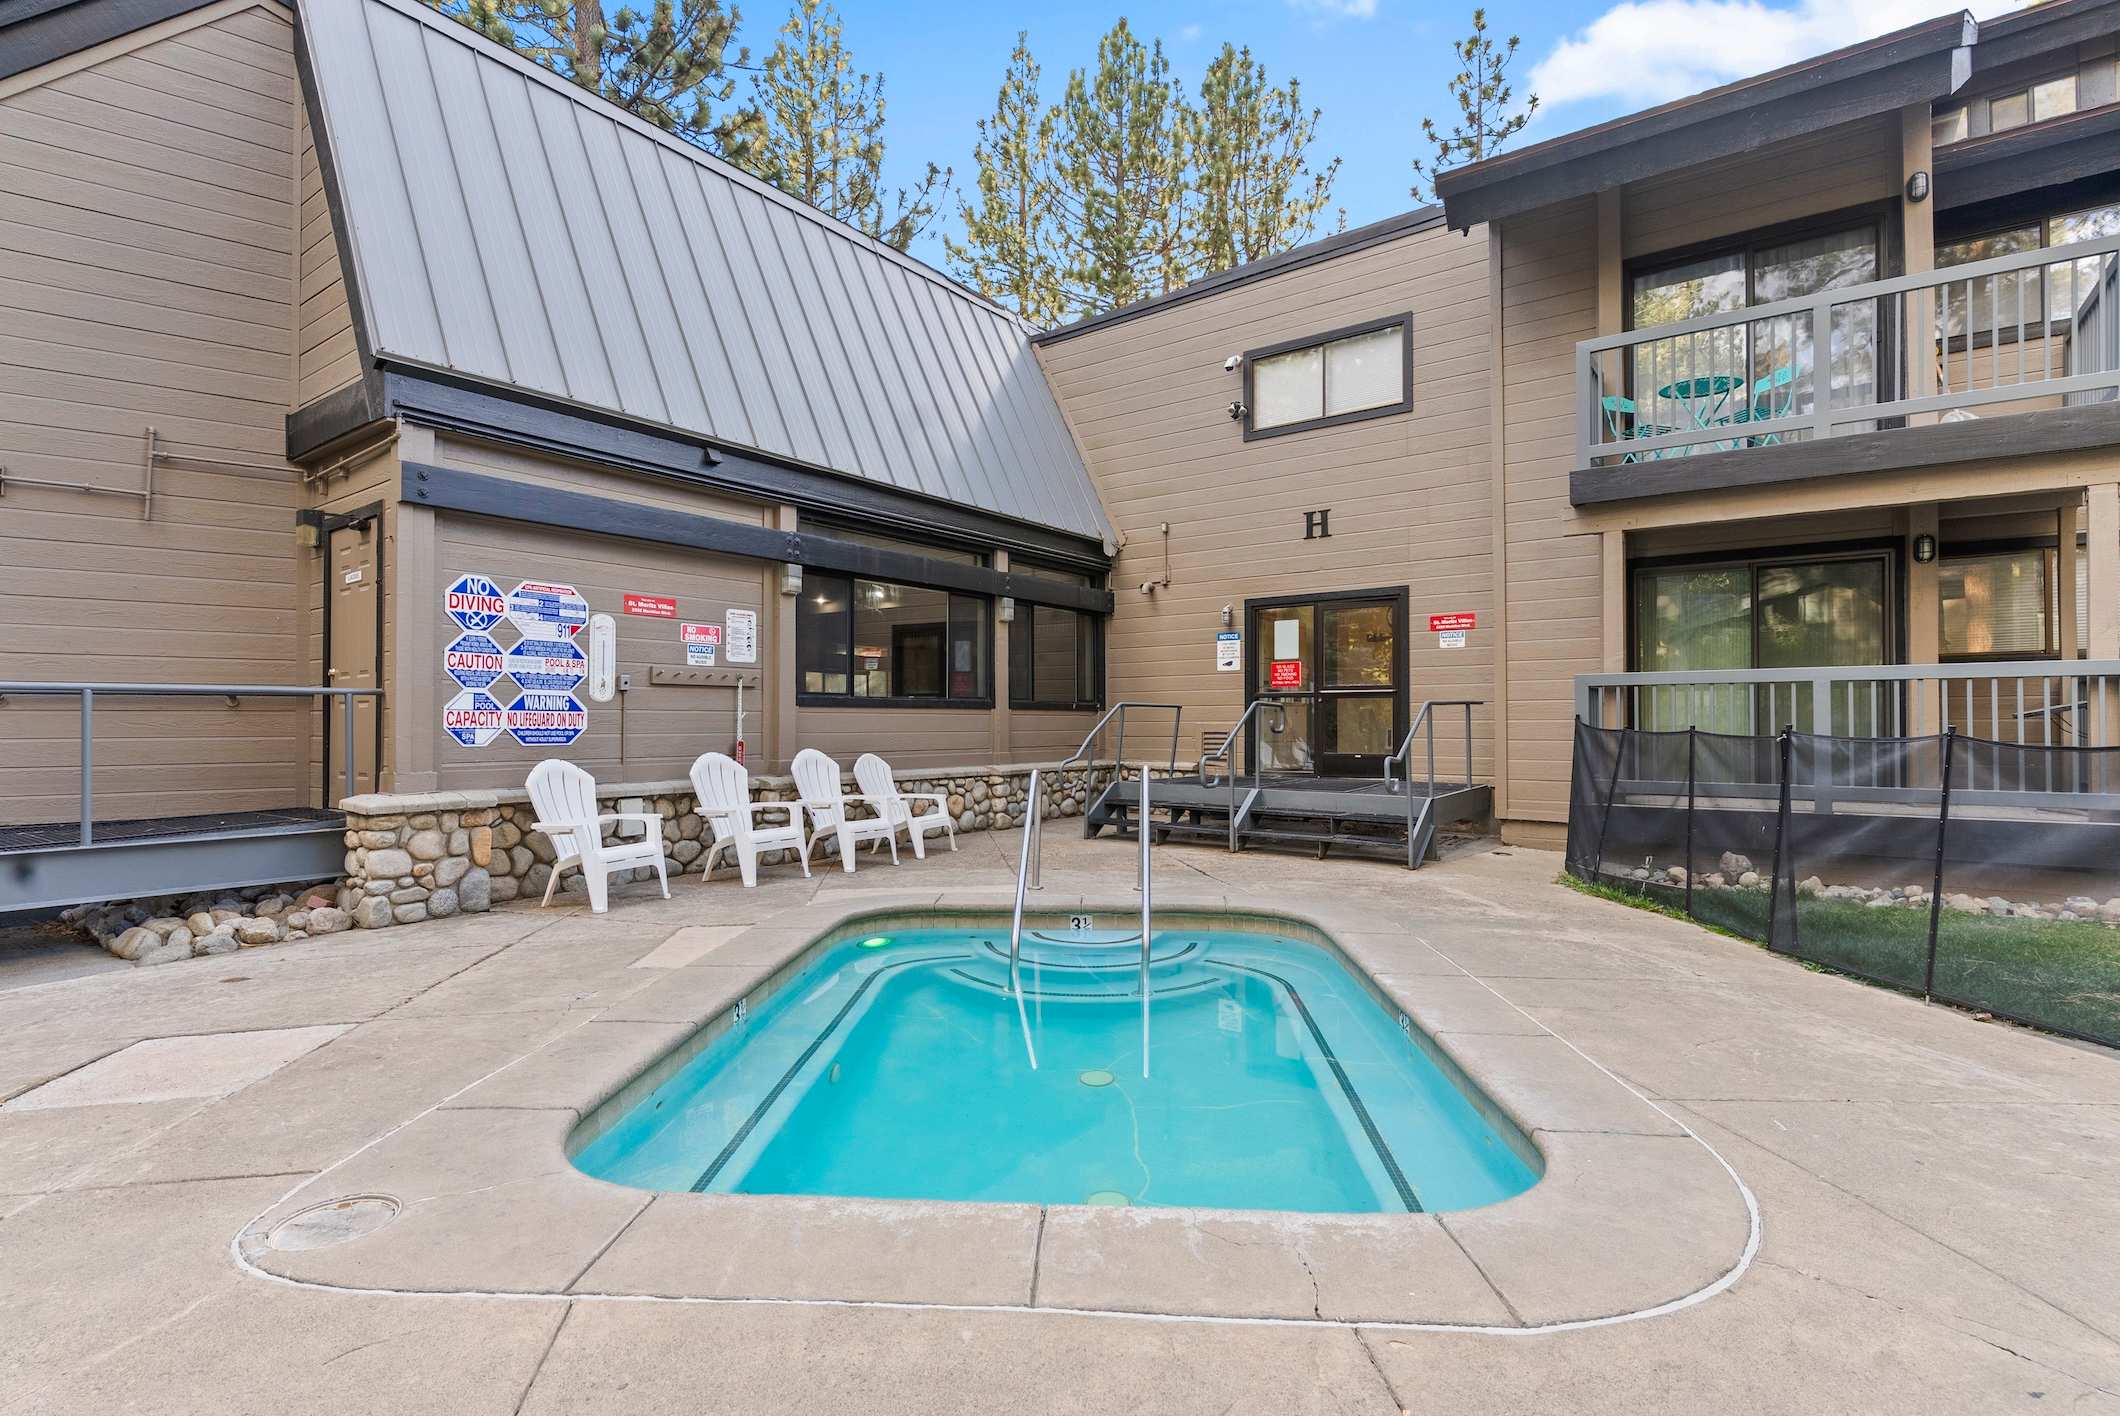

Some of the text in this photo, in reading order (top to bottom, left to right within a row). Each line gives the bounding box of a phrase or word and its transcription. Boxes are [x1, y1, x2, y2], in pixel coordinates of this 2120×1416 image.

[1303, 508, 1332, 540] H
[466, 577, 490, 595] NO
[449, 593, 504, 613] DIVING
[557, 623, 571, 638] 911
[684, 633, 717, 643] SMOKING
[689, 645, 713, 653] NOTICE
[448, 653, 503, 670] CAUTION
[545, 658, 564, 668] POOL
[566, 660, 571, 668] &
[572, 660, 585, 669] SPA
[475, 702, 496, 710] POOL
[523, 695, 570, 711] WARNING
[446, 711, 502, 727] CAPACITY
[507, 712, 585, 727] NO LIFEGUARD ON DUTY
